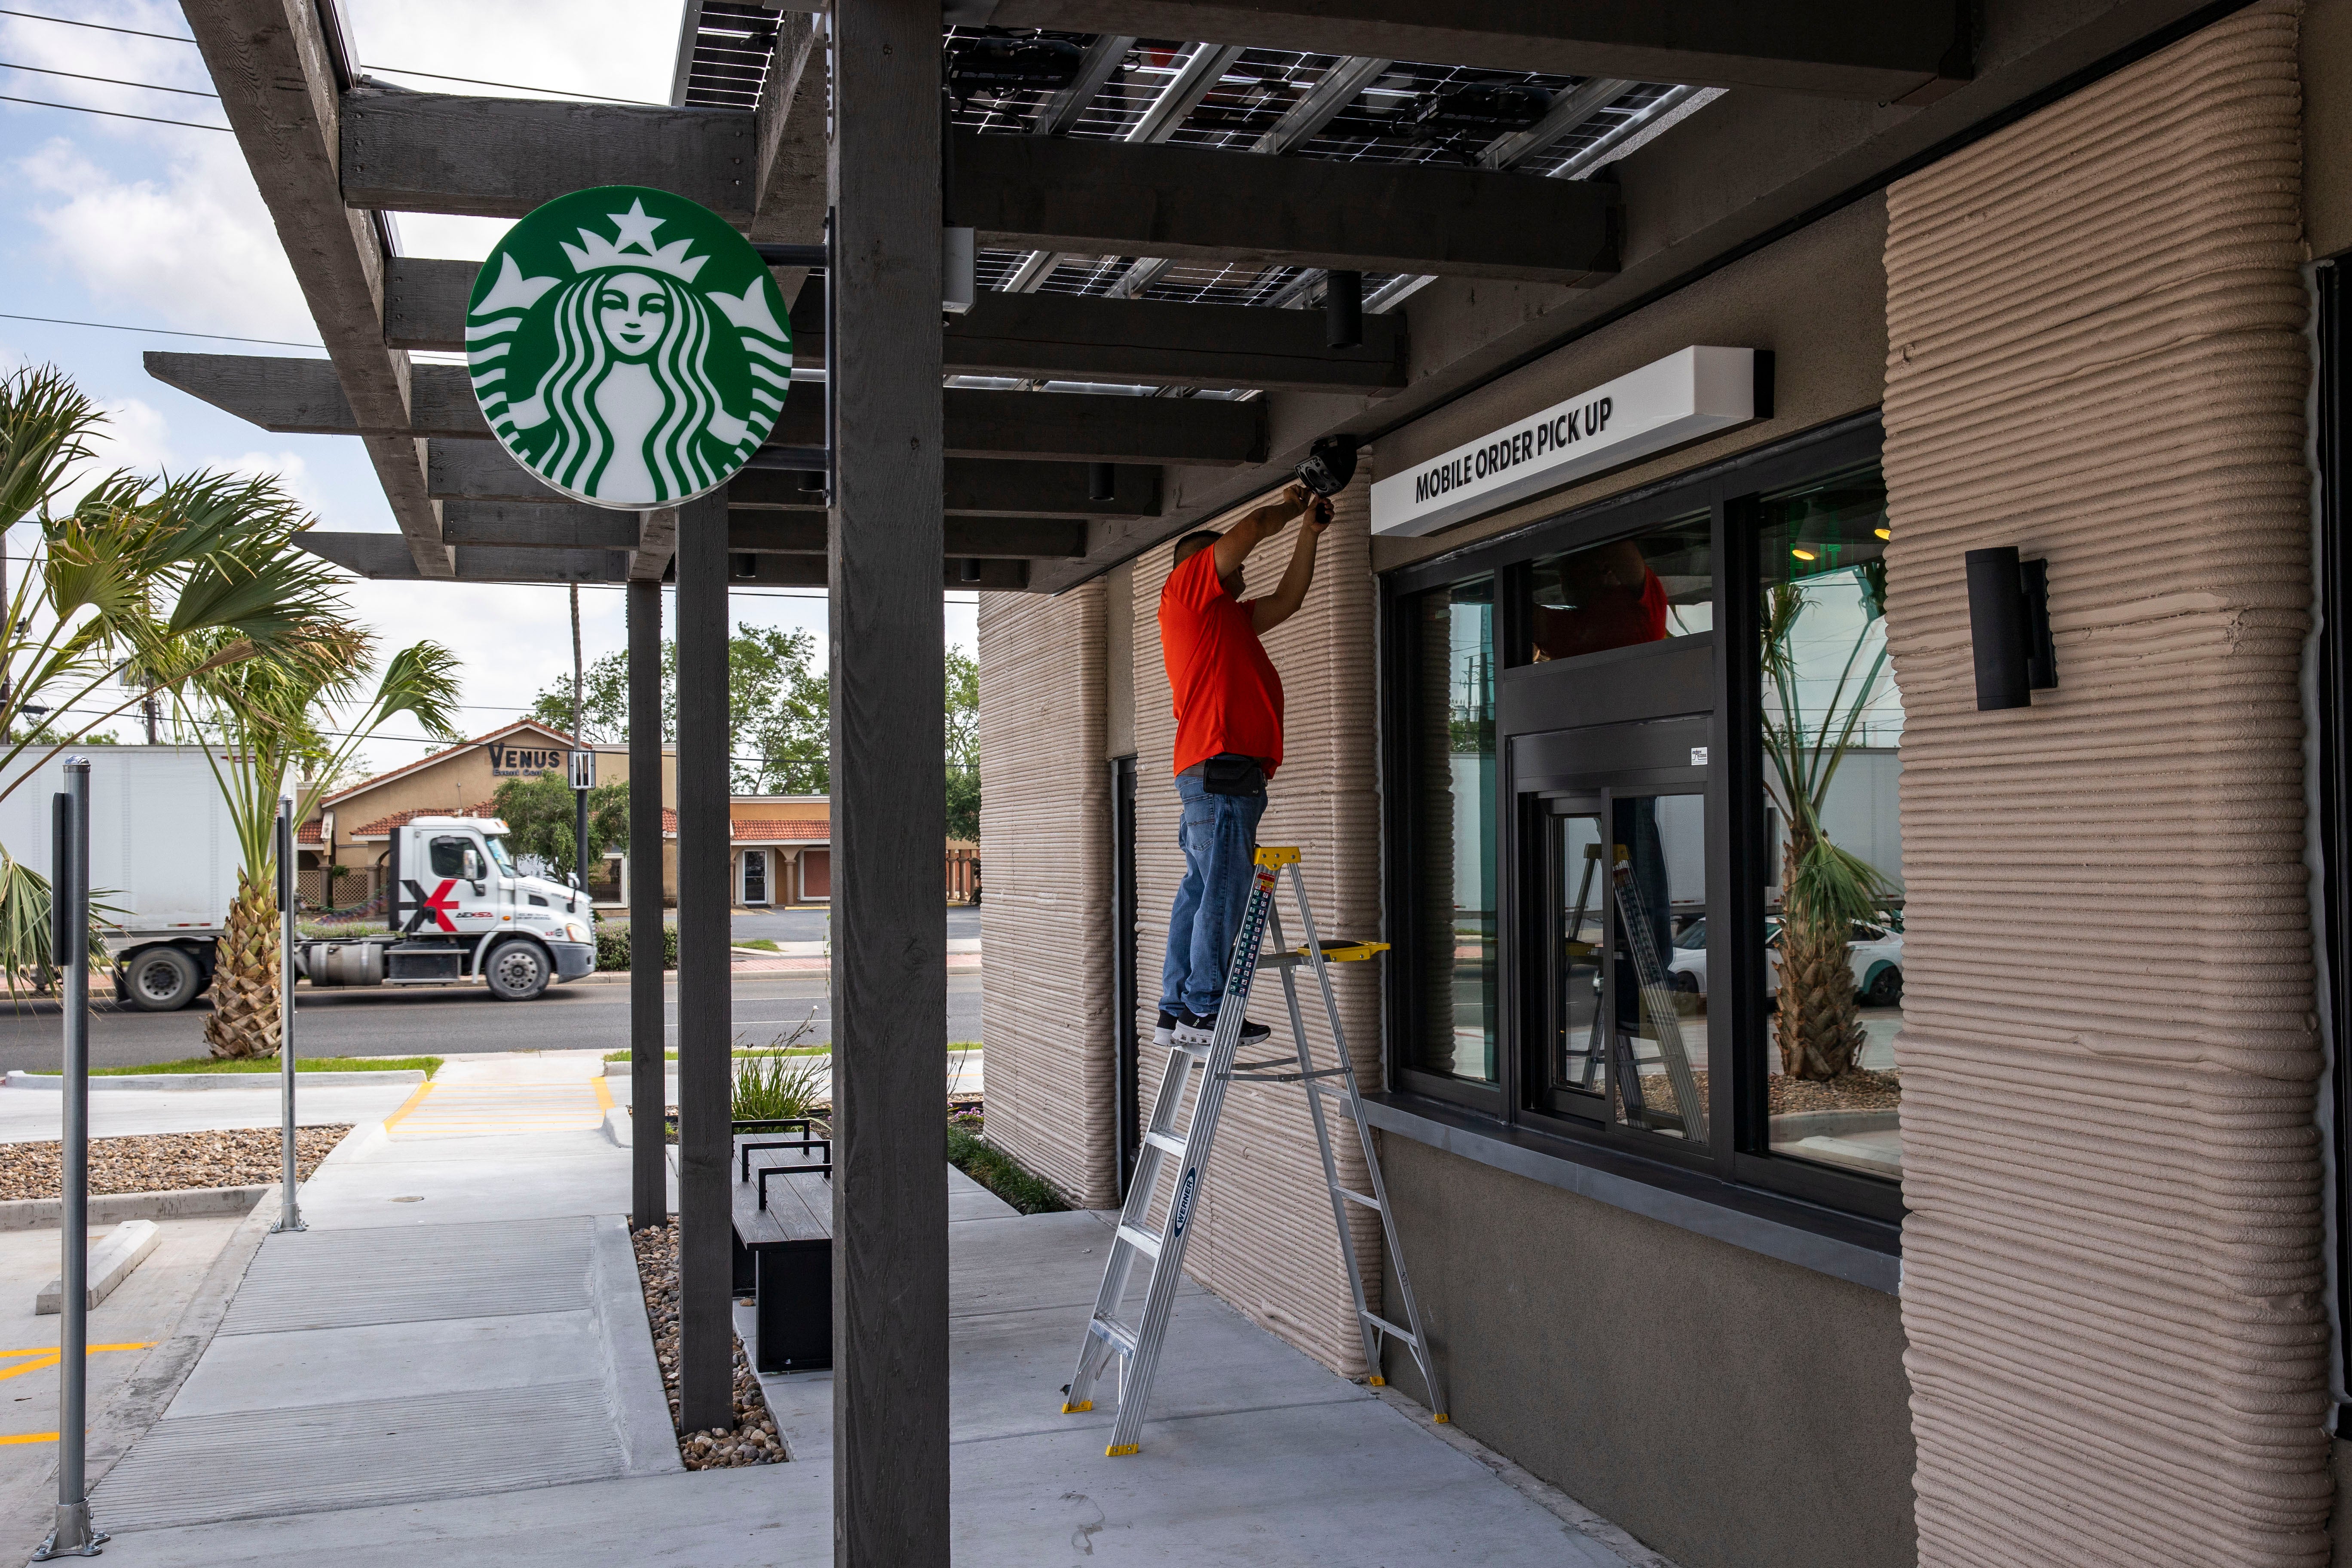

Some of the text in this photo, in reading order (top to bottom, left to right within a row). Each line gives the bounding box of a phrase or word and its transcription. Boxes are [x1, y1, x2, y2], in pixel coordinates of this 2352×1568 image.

[1416, 397, 1613, 503] MOBILE ORDER PICK UP
[488, 742, 560, 768] VENUS
[1177, 1180, 1192, 1223] WERNER
